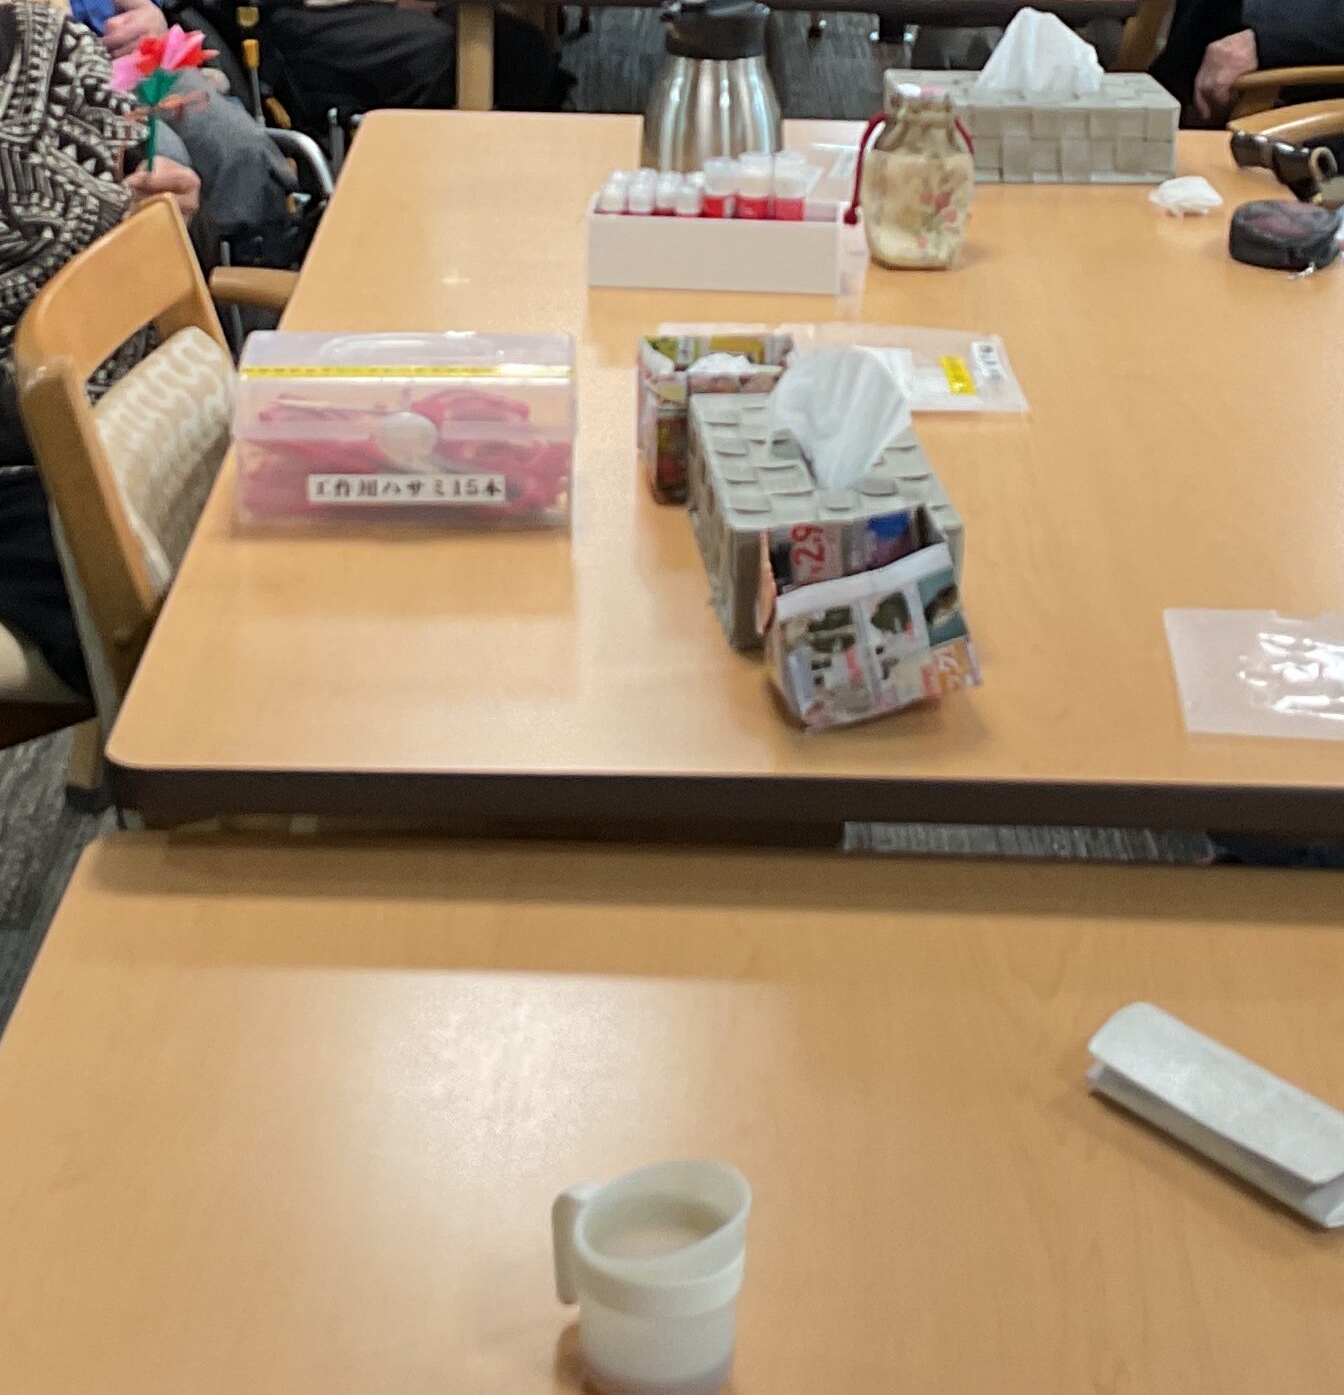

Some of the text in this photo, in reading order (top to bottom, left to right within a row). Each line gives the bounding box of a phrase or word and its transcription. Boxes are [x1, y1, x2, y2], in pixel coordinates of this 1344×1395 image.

[314, 477, 502, 498] 工作用ハサミ15本
